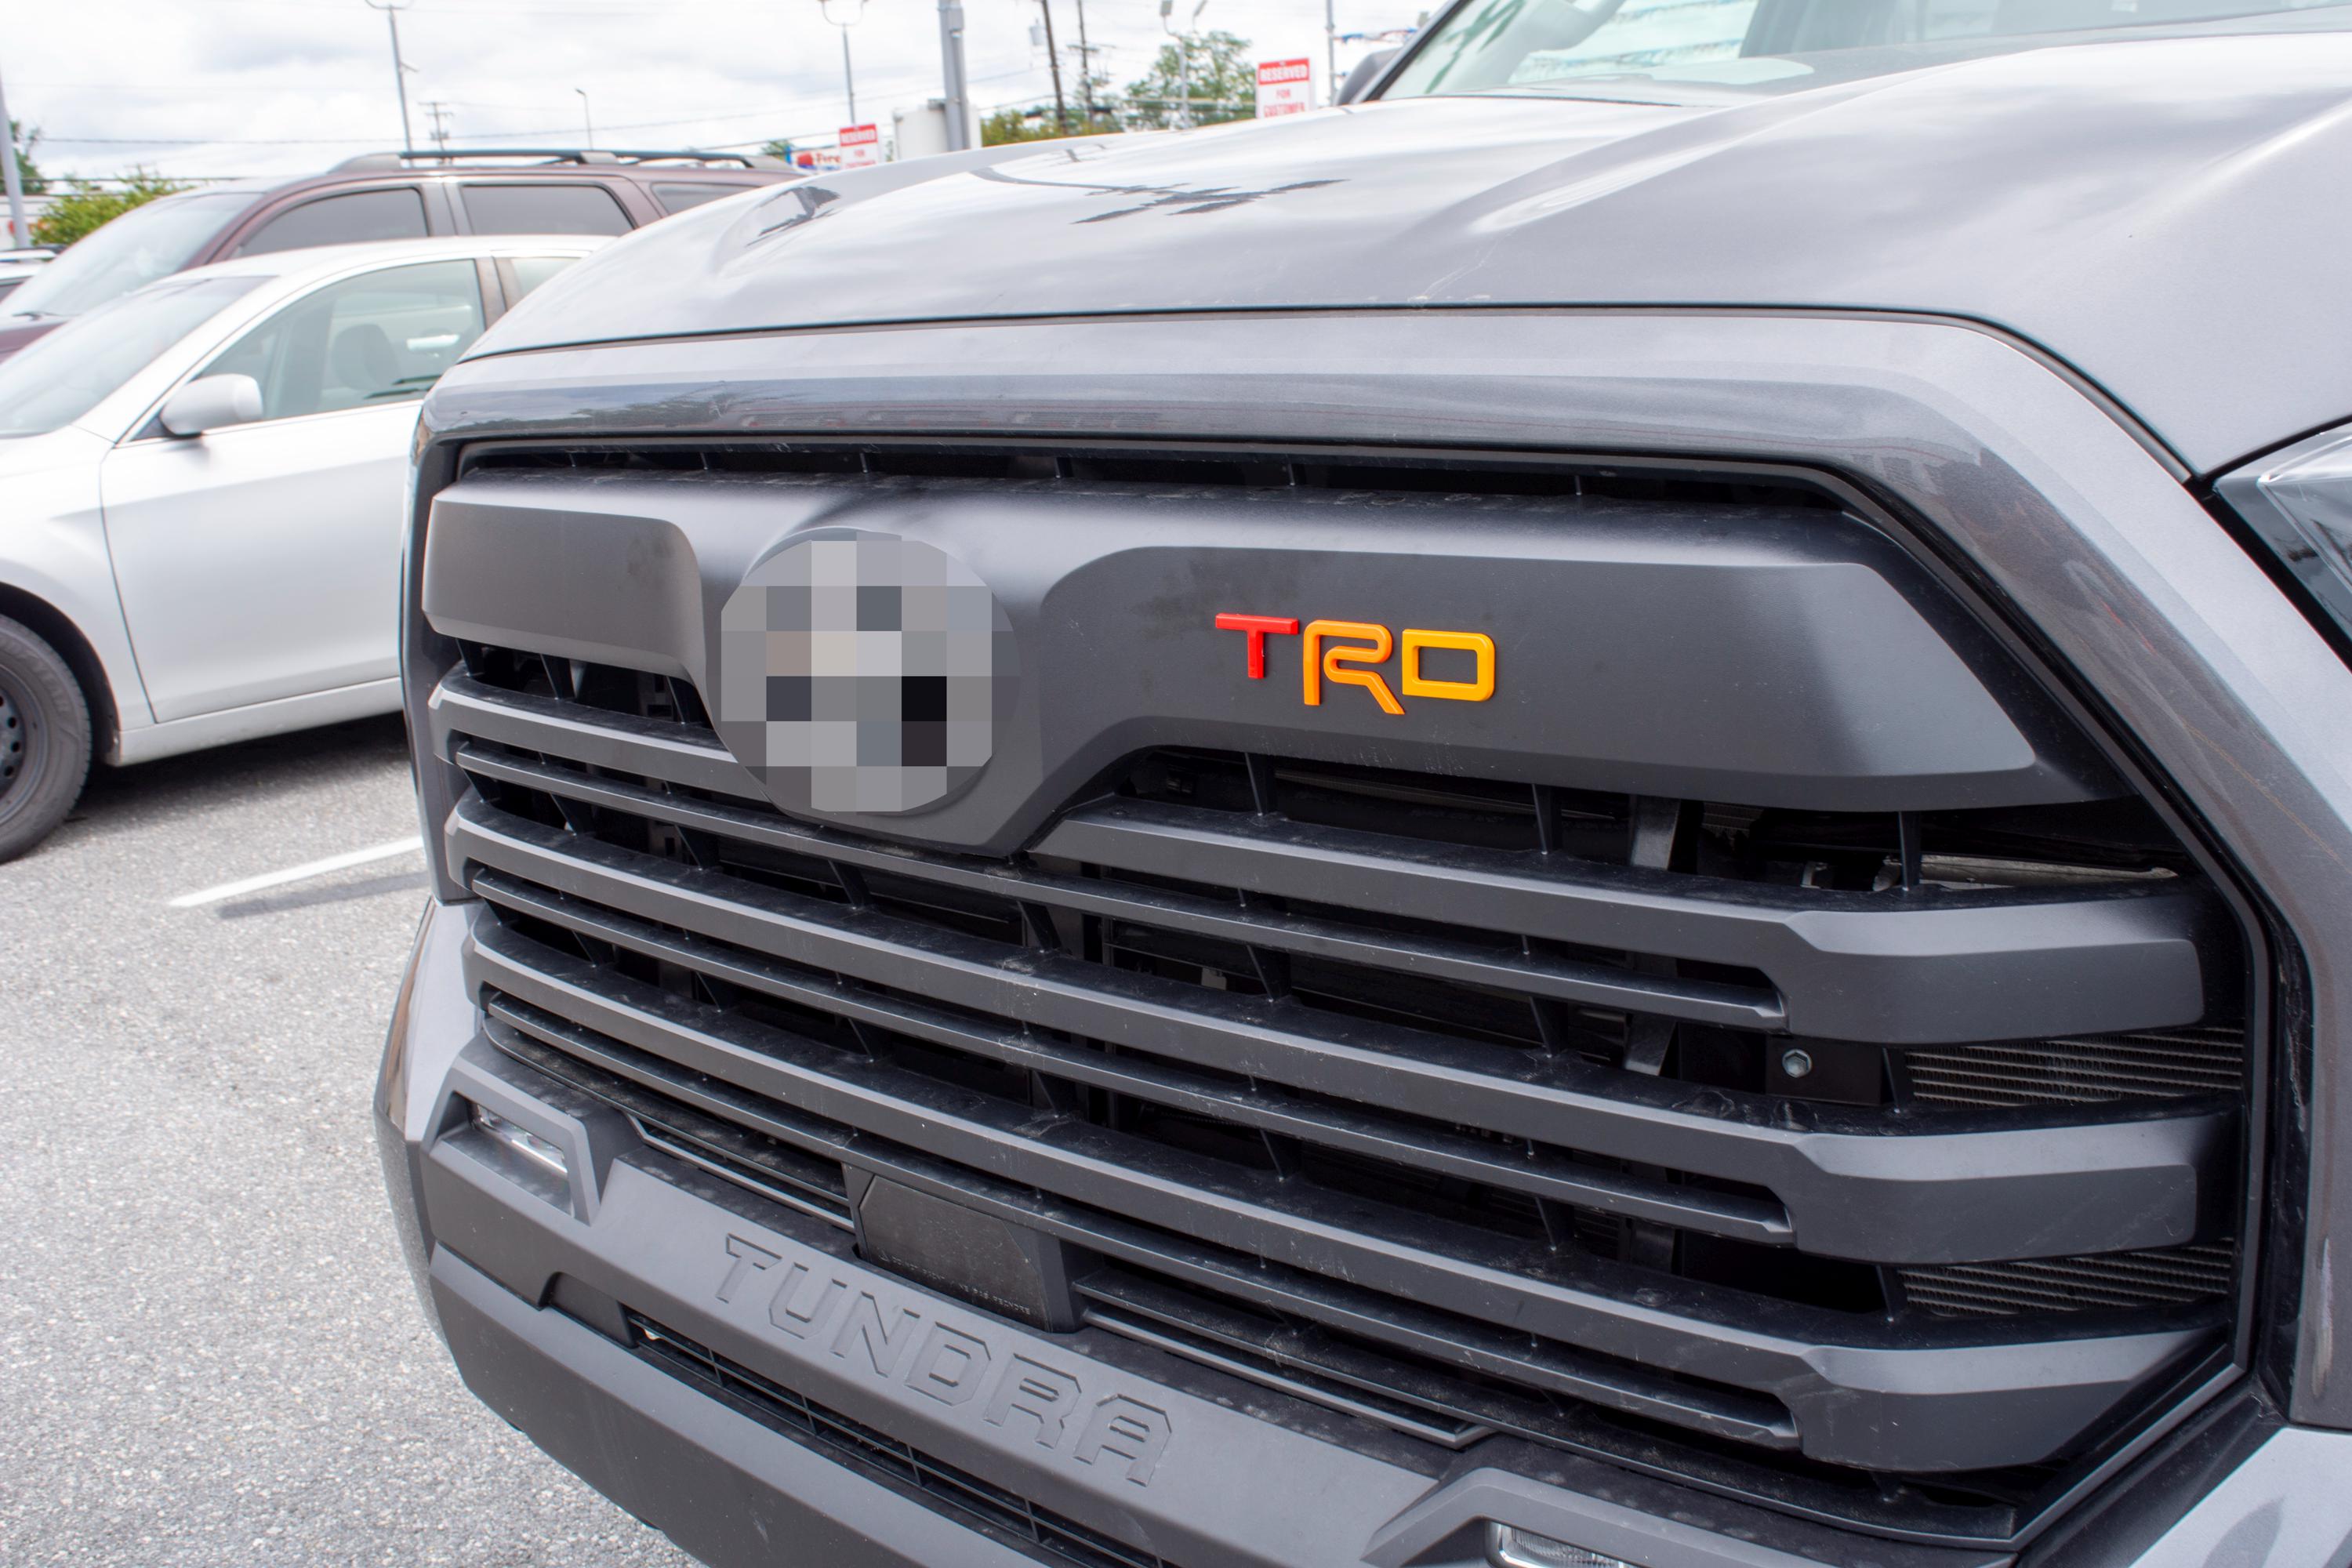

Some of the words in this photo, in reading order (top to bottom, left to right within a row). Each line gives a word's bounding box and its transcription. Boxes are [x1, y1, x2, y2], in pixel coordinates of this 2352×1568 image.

[1260, 64, 1307, 82] RESERVED
[1215, 613, 1495, 715] TRD
[715, 1232, 1172, 1487] TUNDRA
